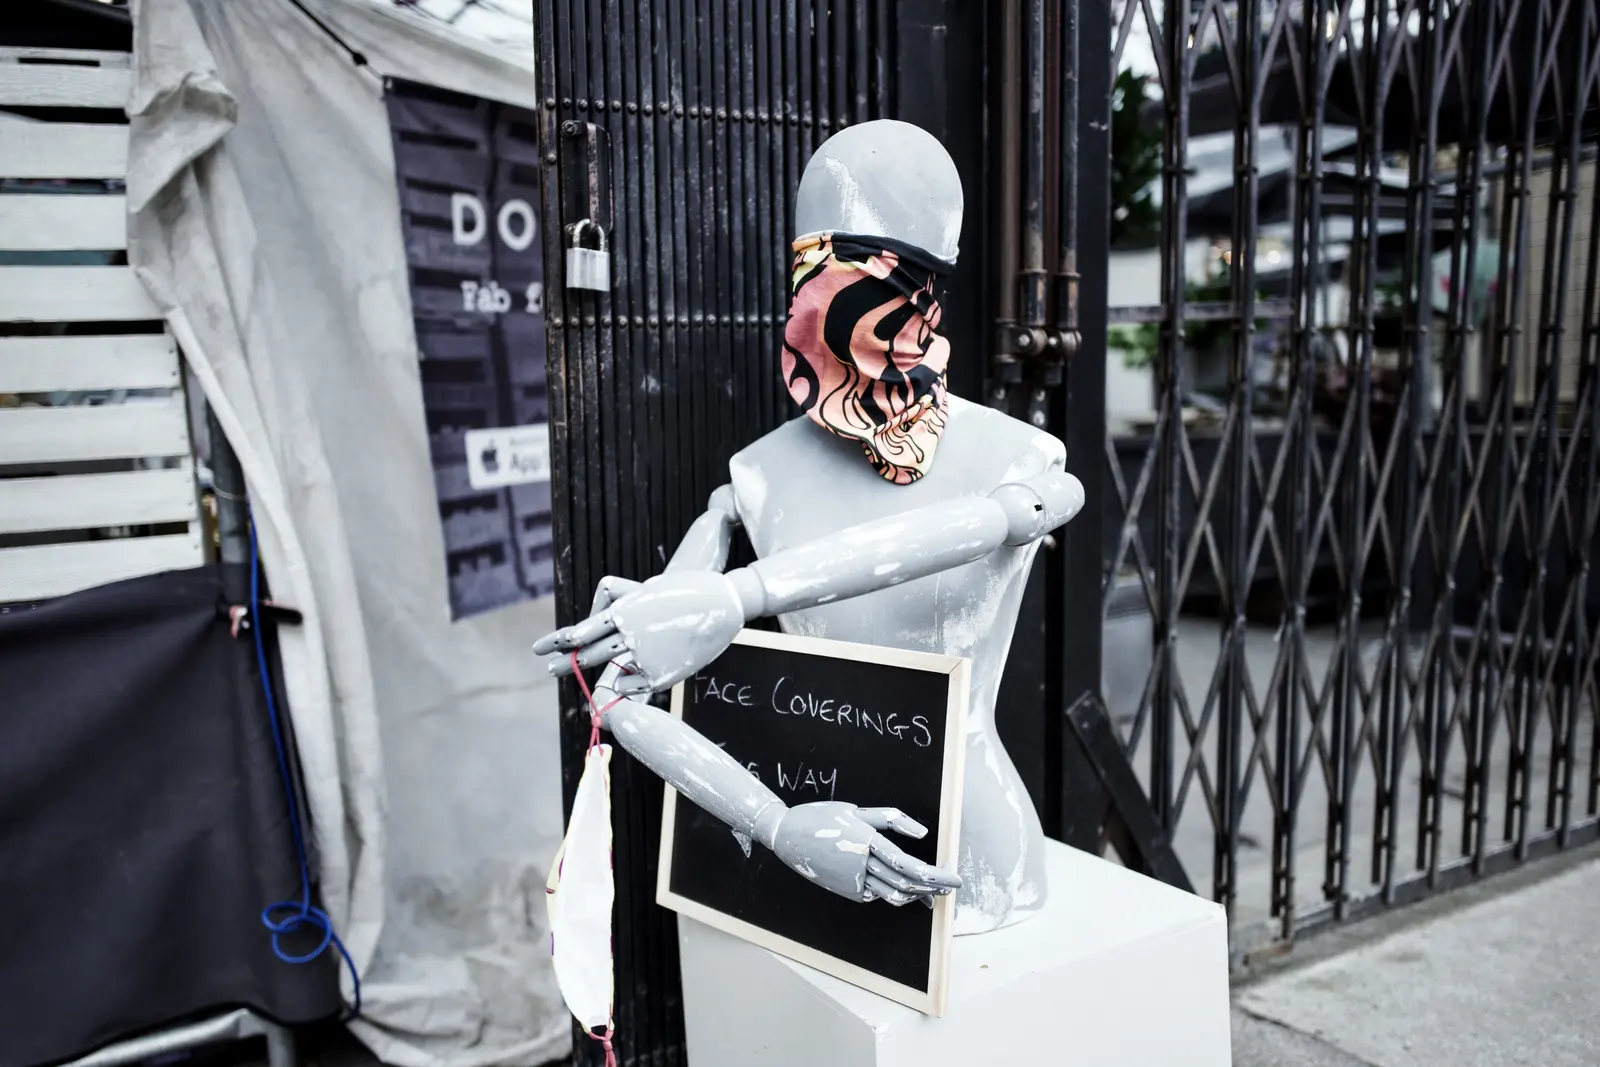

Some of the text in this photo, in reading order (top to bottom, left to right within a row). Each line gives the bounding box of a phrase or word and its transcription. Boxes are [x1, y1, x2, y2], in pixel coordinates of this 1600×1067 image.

[460, 280, 511, 312] Fab
[694, 672, 932, 747] FACE COVERINGS
[777, 762, 837, 801] WAY
